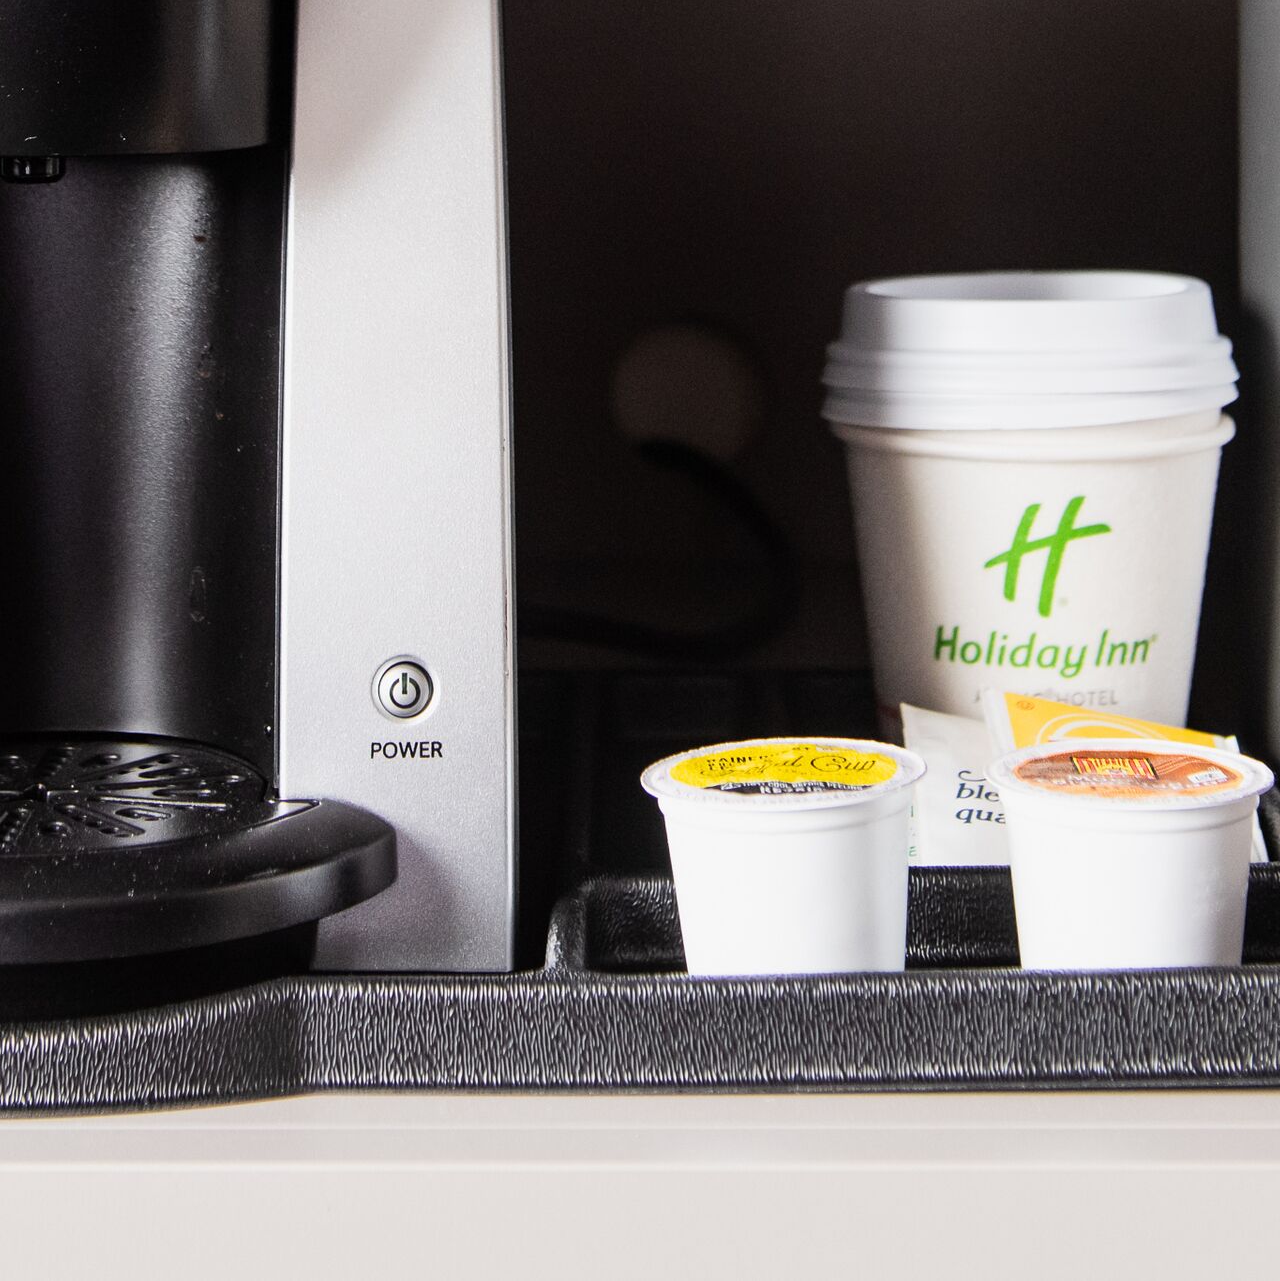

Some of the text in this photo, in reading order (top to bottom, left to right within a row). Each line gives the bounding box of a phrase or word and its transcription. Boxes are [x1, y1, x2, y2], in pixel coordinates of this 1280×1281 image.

[933, 625, 1151, 679] Holiday Inn
[1055, 690, 1119, 707] HOTEL
[370, 741, 443, 759] POWER
[956, 783, 1000, 802] ble
[956, 808, 1007, 824] qua
